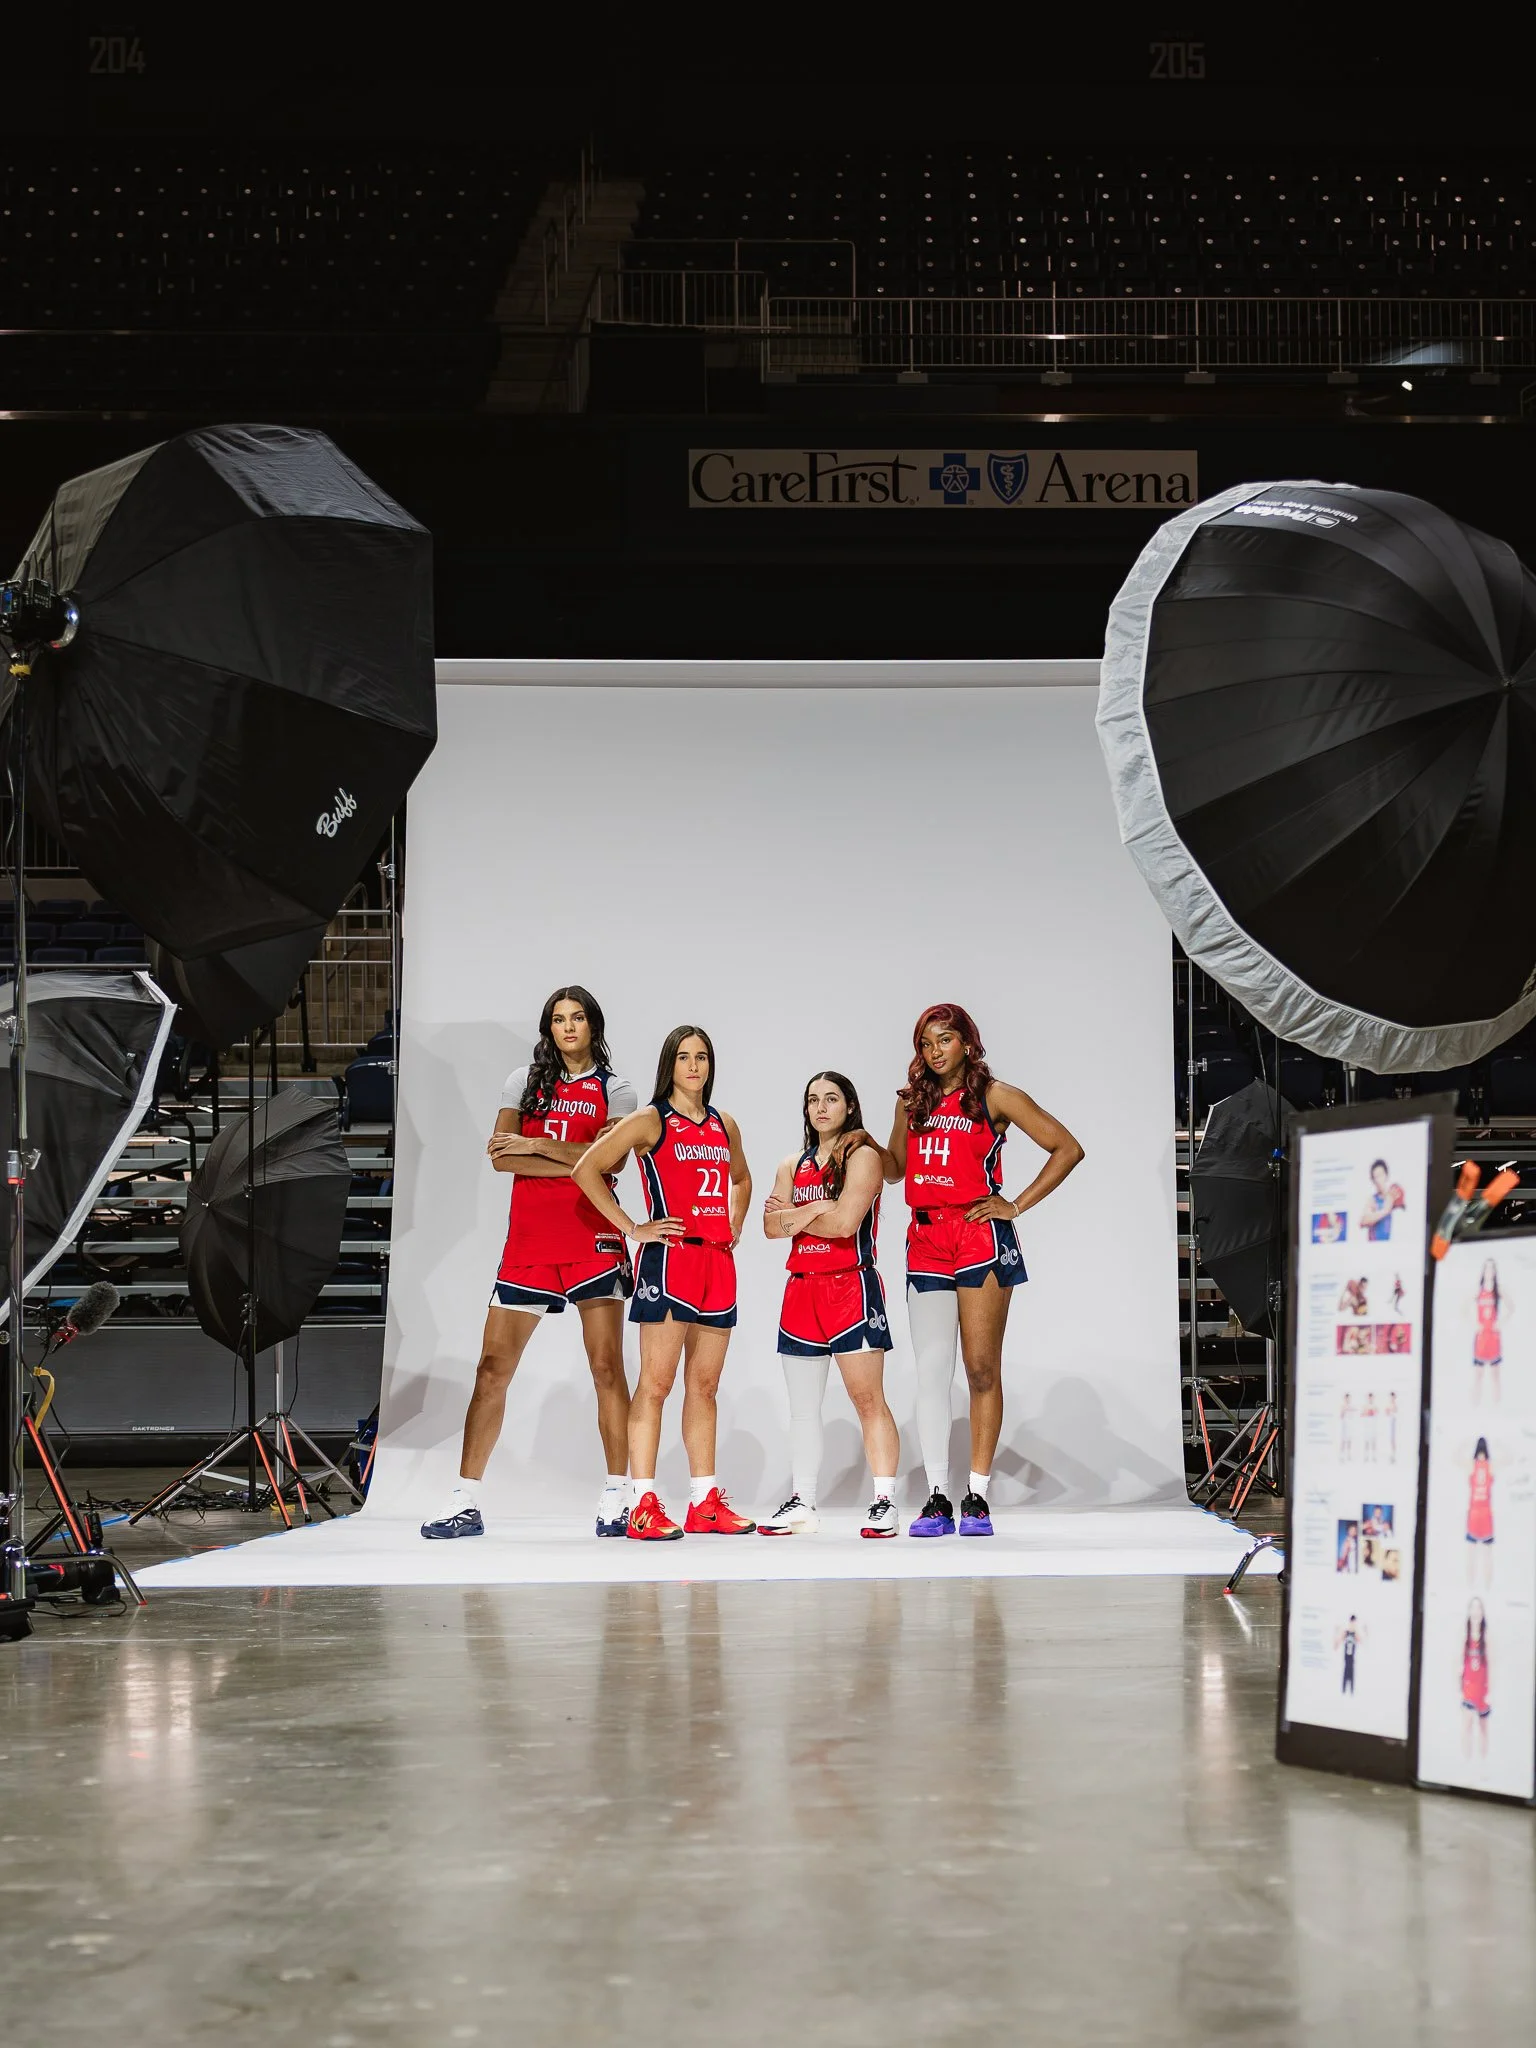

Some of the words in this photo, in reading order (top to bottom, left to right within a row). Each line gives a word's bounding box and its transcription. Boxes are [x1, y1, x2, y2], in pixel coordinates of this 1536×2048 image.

[88, 36, 146, 74] 204
[1148, 42, 1206, 79] 205
[1036, 452, 1194, 504] Arena
[918, 1136, 950, 1166] 44
[696, 1167, 723, 1197] 22
